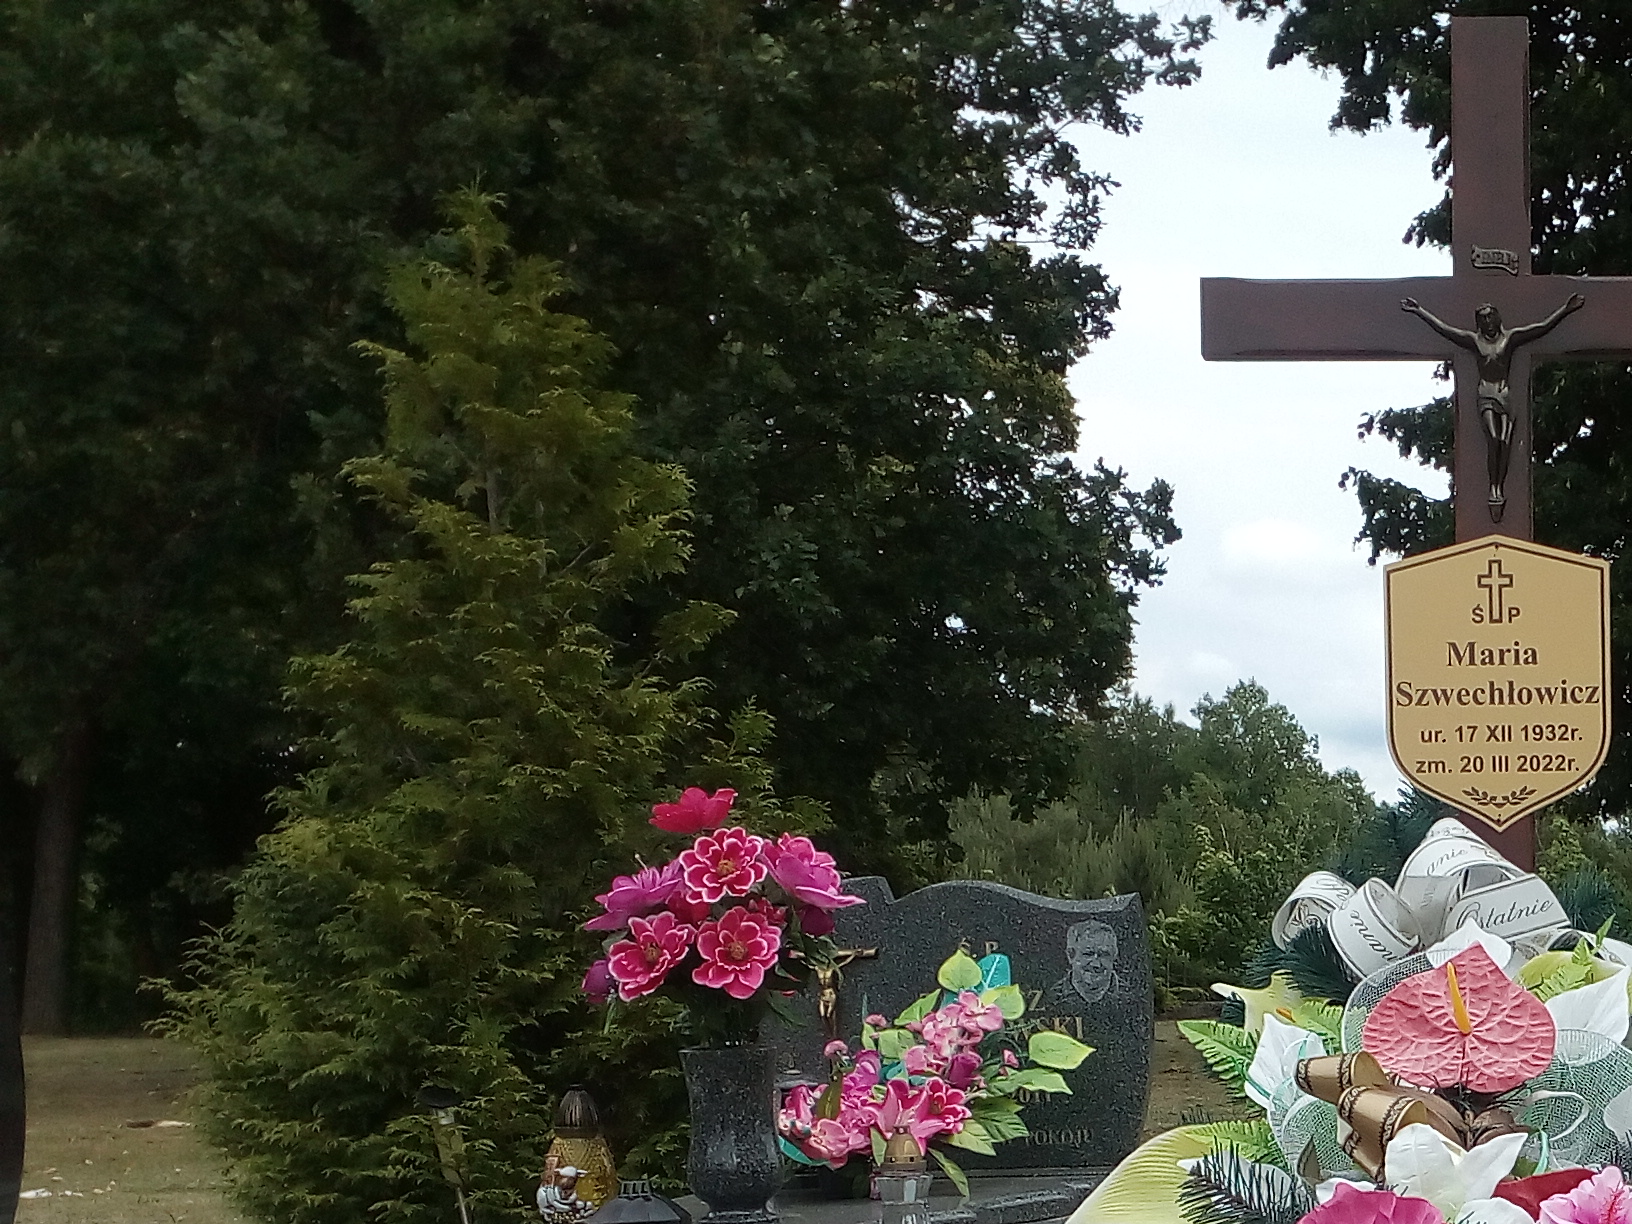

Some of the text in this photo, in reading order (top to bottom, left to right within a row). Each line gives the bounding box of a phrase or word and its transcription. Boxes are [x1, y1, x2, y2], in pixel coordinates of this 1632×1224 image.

[1508, 606, 1521, 624] P
[1446, 640, 1539, 667] Maria
[1395, 679, 1601, 708] Szwechłowicz
[1420, 724, 1583, 743] ur. 17 XII 1932r.
[1415, 754, 1581, 774] zm. 20 III 2022r.
